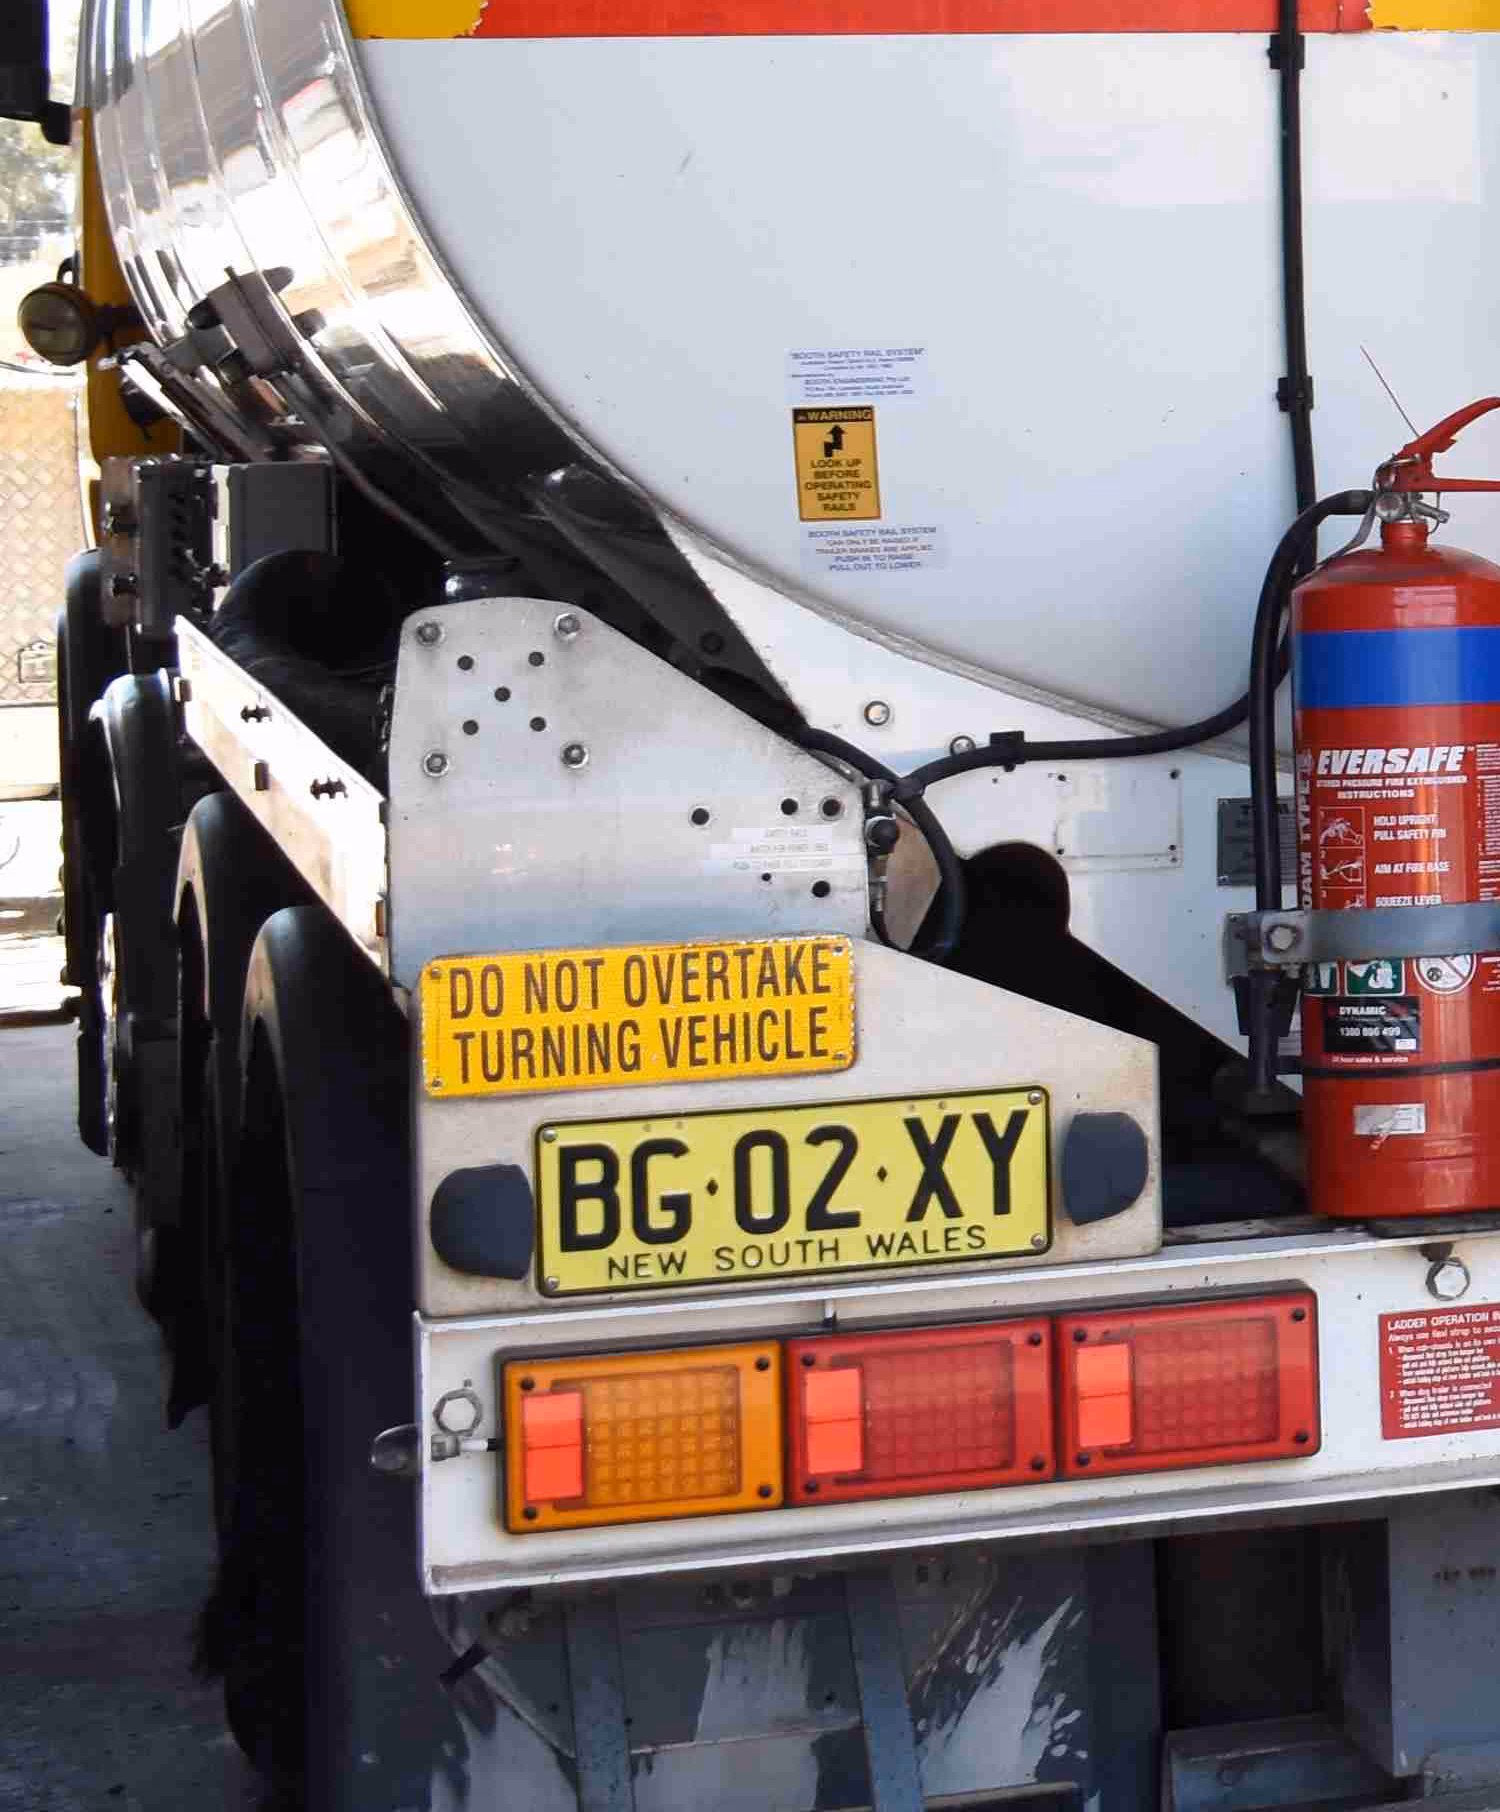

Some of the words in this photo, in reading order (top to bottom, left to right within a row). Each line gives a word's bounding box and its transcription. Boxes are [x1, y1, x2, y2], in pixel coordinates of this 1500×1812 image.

[807, 409, 872, 420] WARNING
[811, 459, 843, 468] LOOK
[846, 458, 863, 467] UP
[814, 469, 861, 479] BEFORE
[804, 480, 873, 490] OPERATING
[816, 491, 861, 501] SAFETY
[823, 502, 857, 512] RAILS
[843, 529, 876, 537] SAFETY
[1316, 745, 1466, 775] EVERSAFE
[1342, 779, 1383, 787] PRESSURE
[1385, 777, 1404, 786] FIRE
[1407, 775, 1467, 785] EXTINGUISHER
[1337, 789, 1415, 799] INSTRUCTIONS
[1374, 815, 1397, 826] HOLD
[1374, 830, 1395, 840] PULL
[1397, 829, 1429, 840] SAFETY
[1431, 828, 1446, 838] PIN
[1375, 863, 1391, 874] AIM
[1393, 863, 1404, 873] AT
[1406, 862, 1425, 872] FIRE
[1426, 861, 1450, 872] BASE
[1375, 896, 1413, 906] SQUEEZE
[1414, 895, 1442, 906] LEVER
[450, 963, 505, 1020] DO
[524, 956, 606, 1015] NOT
[624, 943, 833, 1008] OVERTAKE
[1339, 1006, 1387, 1015] DYNAMIC
[453, 1019, 641, 1085] TURNING
[659, 1006, 830, 1070] VEHICLE
[608, 1250, 687, 1280] NEW
[714, 1238, 841, 1272] SOUTH
[866, 1224, 987, 1259] WALES
[1387, 1317, 1428, 1331] LADDER
[1431, 1312, 1489, 1327] OPERATION
[1388, 1332, 1414, 1343] Always
[1415, 1332, 1429, 1340] use
[1450, 1327, 1471, 1338] strap
[1473, 1327, 1482, 1335] to
